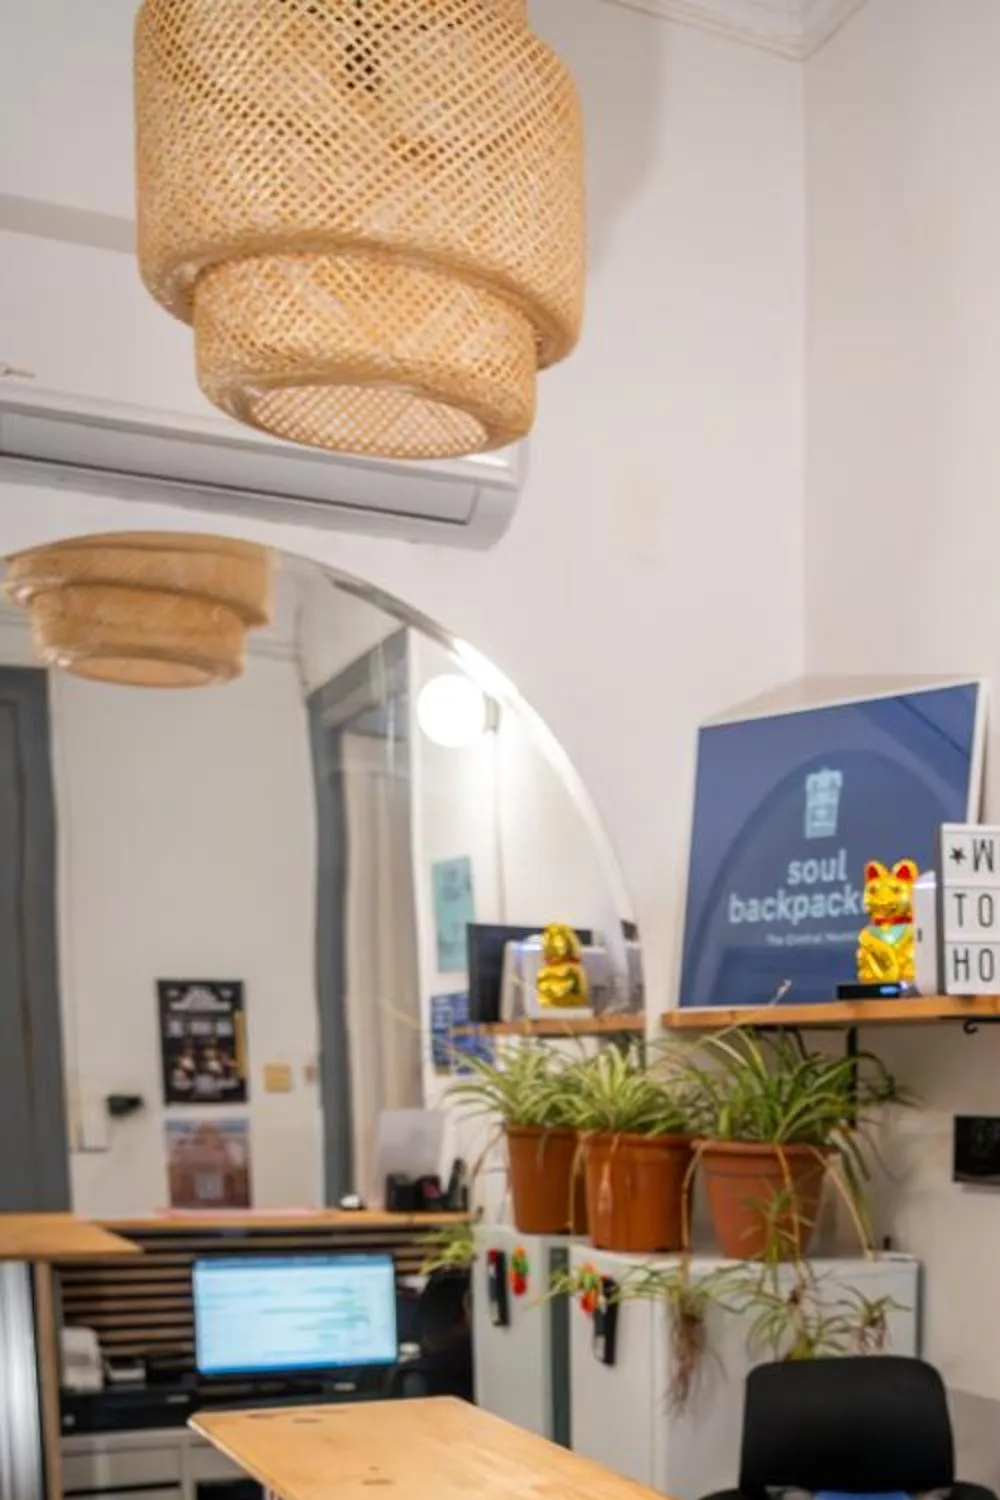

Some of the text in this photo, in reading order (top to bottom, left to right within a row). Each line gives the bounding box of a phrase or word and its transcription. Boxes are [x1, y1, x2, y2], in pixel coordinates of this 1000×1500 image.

[787, 848, 848, 885] soul
[728, 884, 866, 927] backpack
[953, 892, 995, 929] TO
